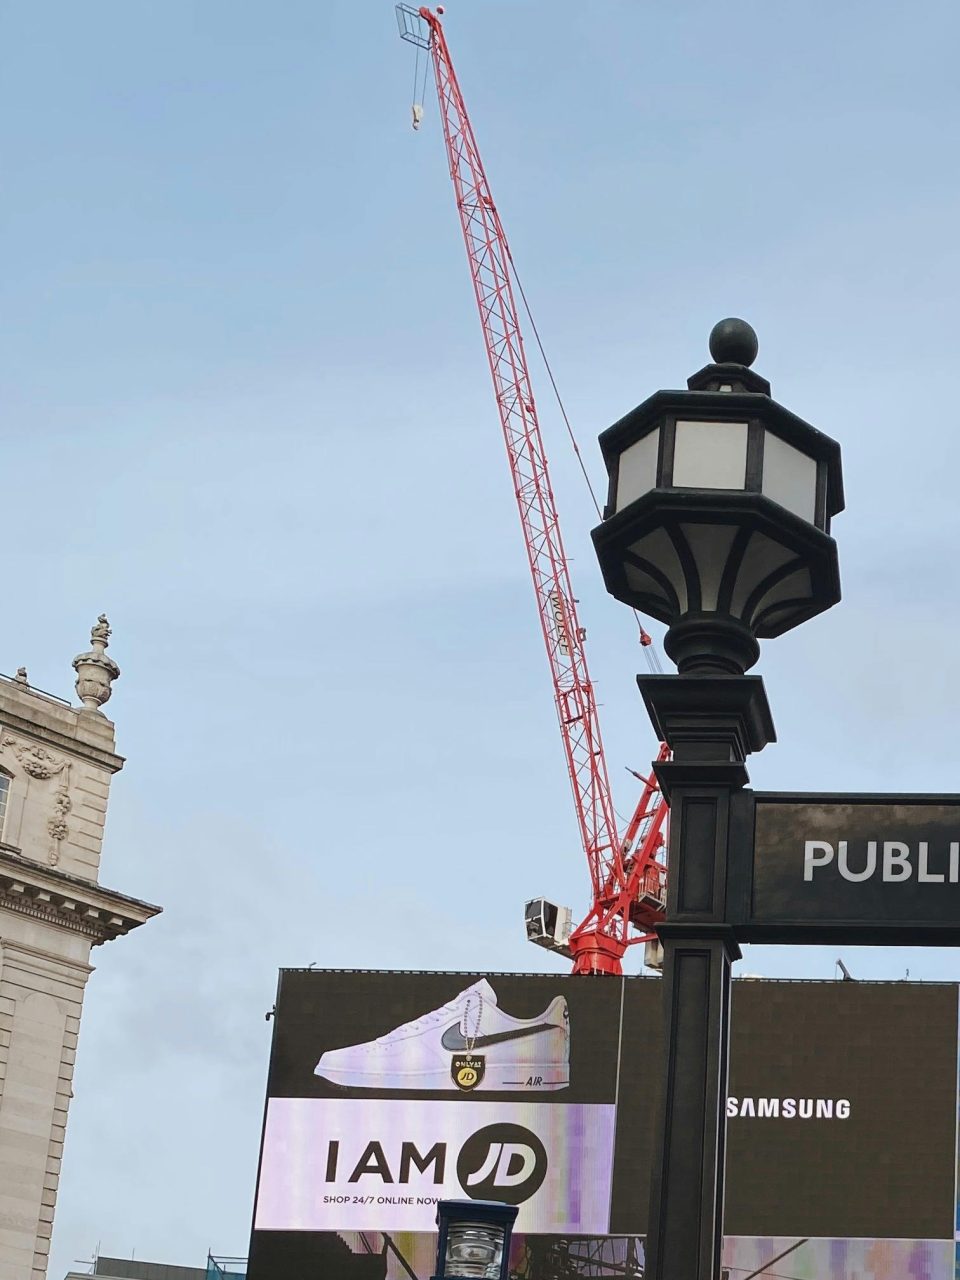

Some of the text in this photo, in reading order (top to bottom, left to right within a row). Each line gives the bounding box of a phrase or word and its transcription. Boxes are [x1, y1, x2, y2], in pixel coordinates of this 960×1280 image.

[525, 1076, 543, 1087] AIR
[726, 1096, 851, 1119] SAMSUNG
[325, 1140, 447, 1184] I AM
[466, 1142, 537, 1187] JD
[323, 1195, 351, 1205] SHOP
[352, 1195, 375, 1205] 24/7
[377, 1196, 415, 1206] ONLINE
